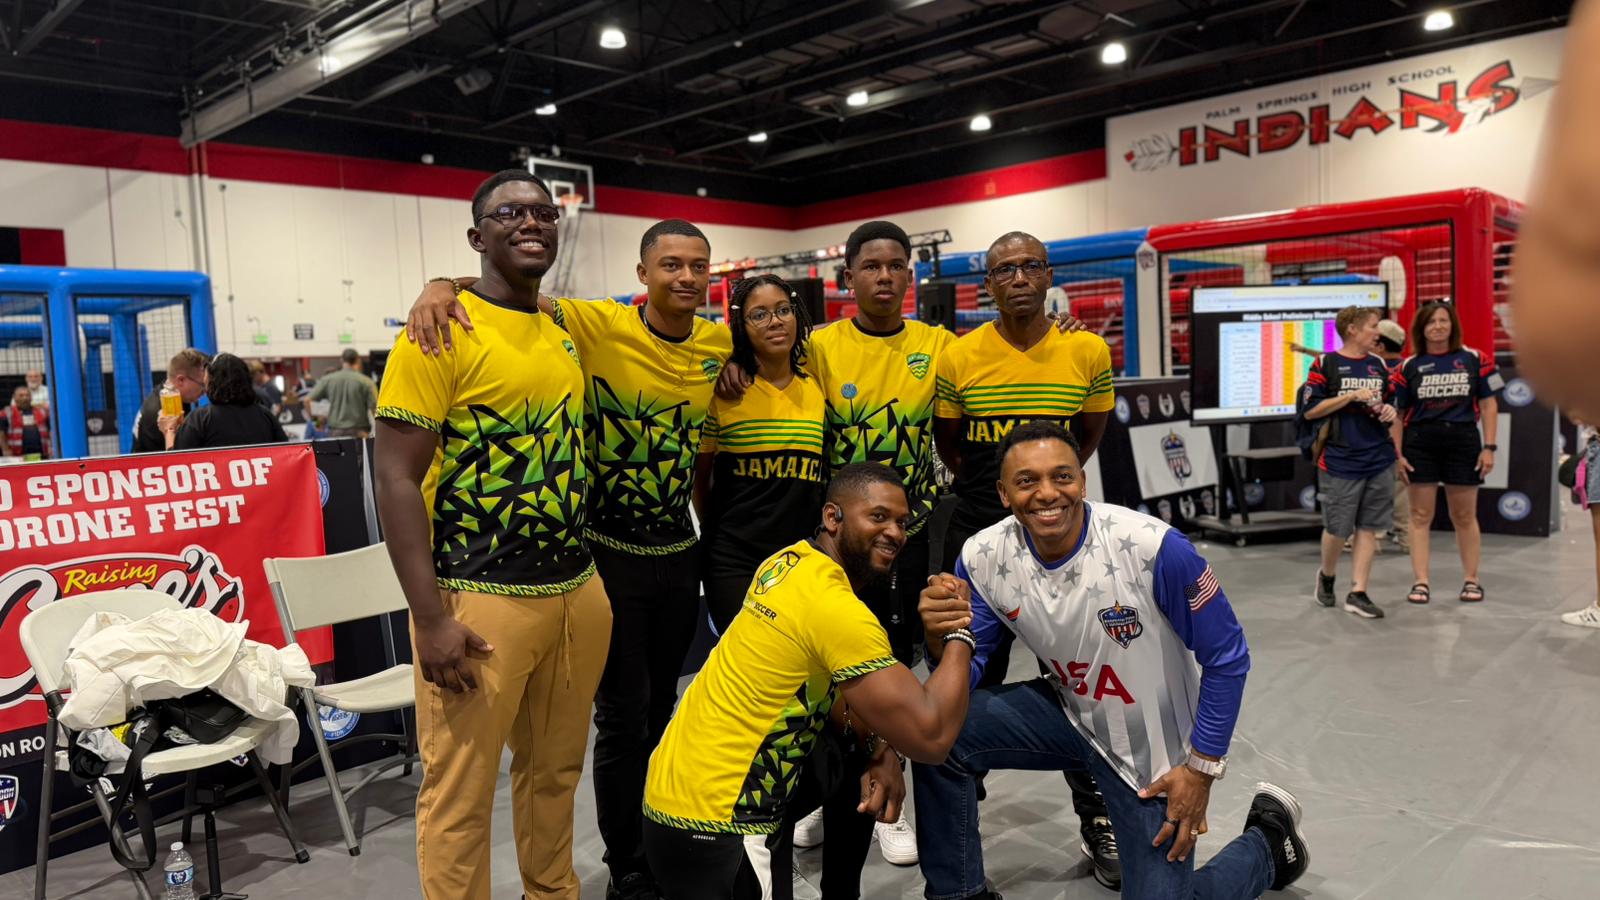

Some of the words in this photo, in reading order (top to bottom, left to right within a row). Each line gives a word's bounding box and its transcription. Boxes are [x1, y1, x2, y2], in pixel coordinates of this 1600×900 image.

[1205, 106, 1241, 119] PALM
[1256, 91, 1319, 111] SPRINGS
[1332, 81, 1372, 96] HIGH
[1387, 66, 1456, 86] SCHOOL
[1179, 60, 1519, 166] INDIANS
[1341, 378, 1383, 389] DRONE
[1417, 384, 1471, 398] SOCCER
[1421, 373, 1469, 386] DRONE
[26, 462, 221, 509] SPONSOR
[228, 457, 273, 488] OF
[733, 456, 822, 482] JAMAIC
[145, 494, 246, 534] FEST
[63, 561, 158, 593] Raising
